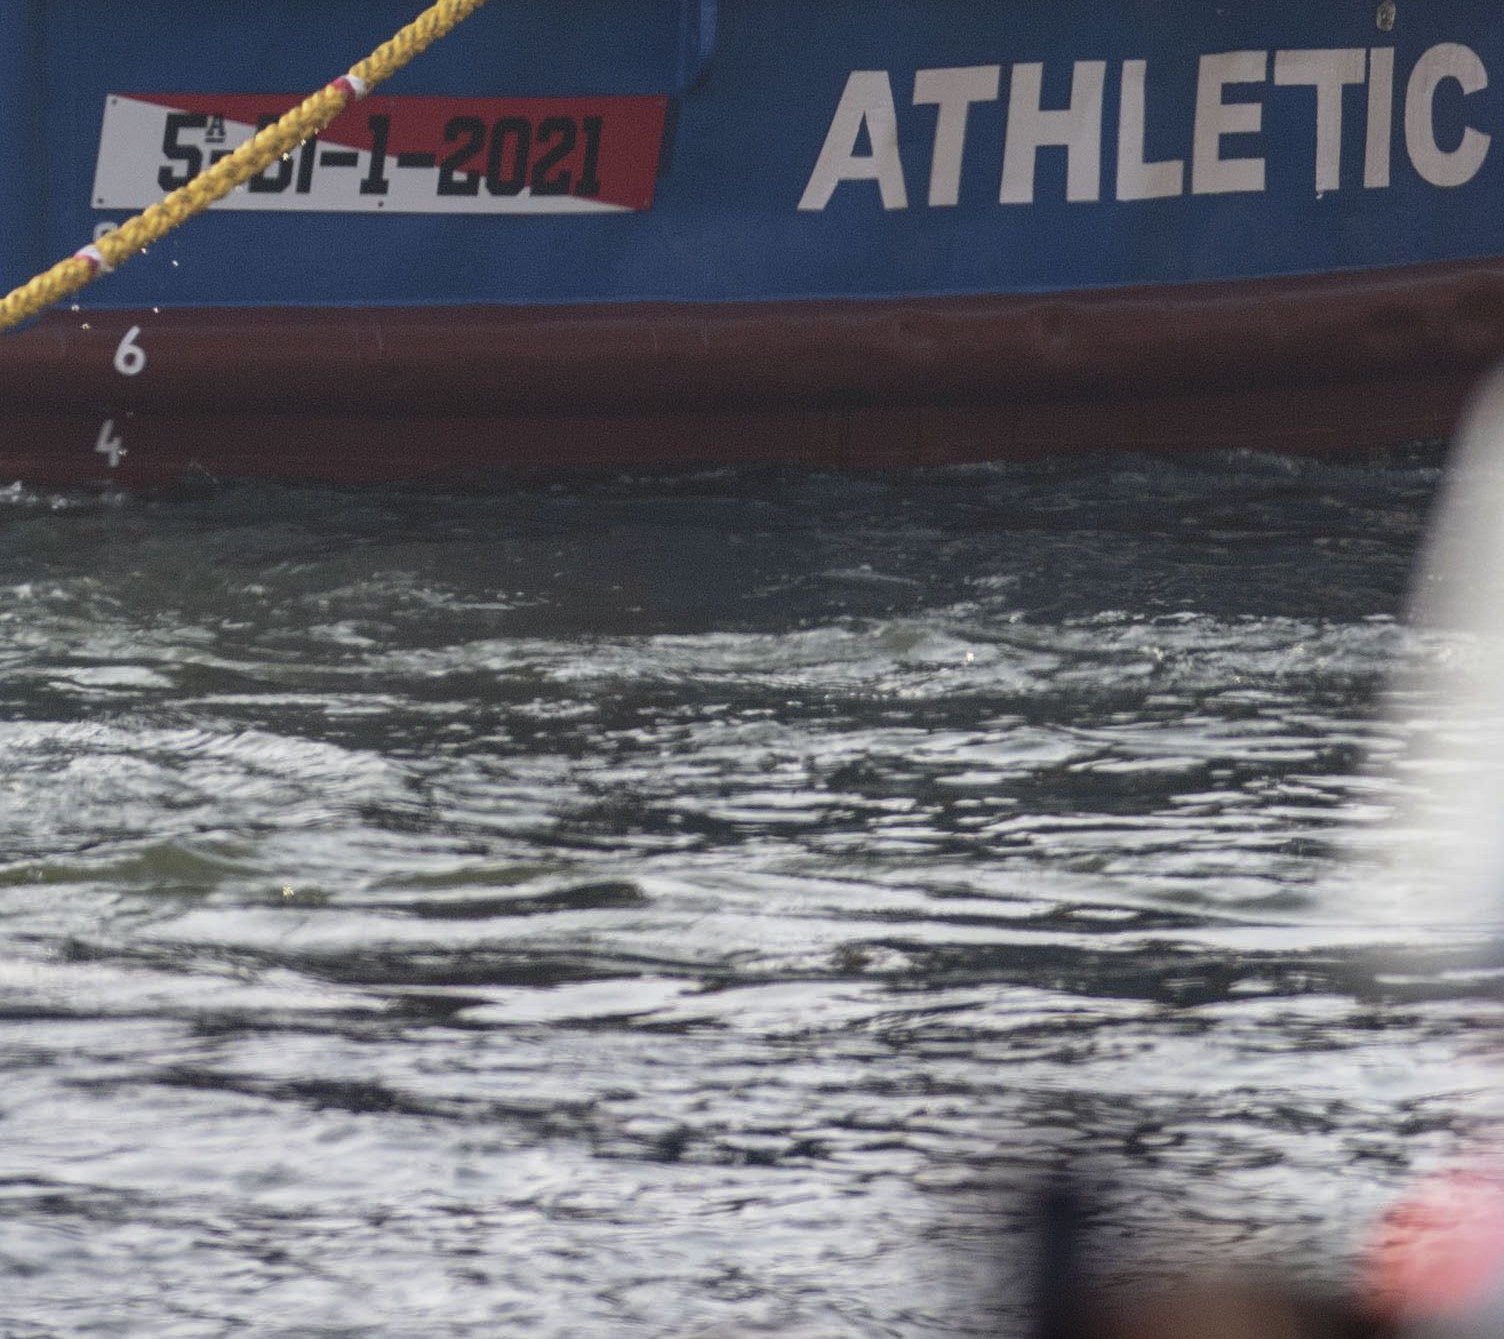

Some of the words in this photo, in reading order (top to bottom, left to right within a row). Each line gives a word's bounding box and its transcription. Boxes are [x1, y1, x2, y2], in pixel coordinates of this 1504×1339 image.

[797, 41, 1492, 212] ATHLETIC
[113, 325, 146, 375] 6
[95, 419, 125, 467] 4
